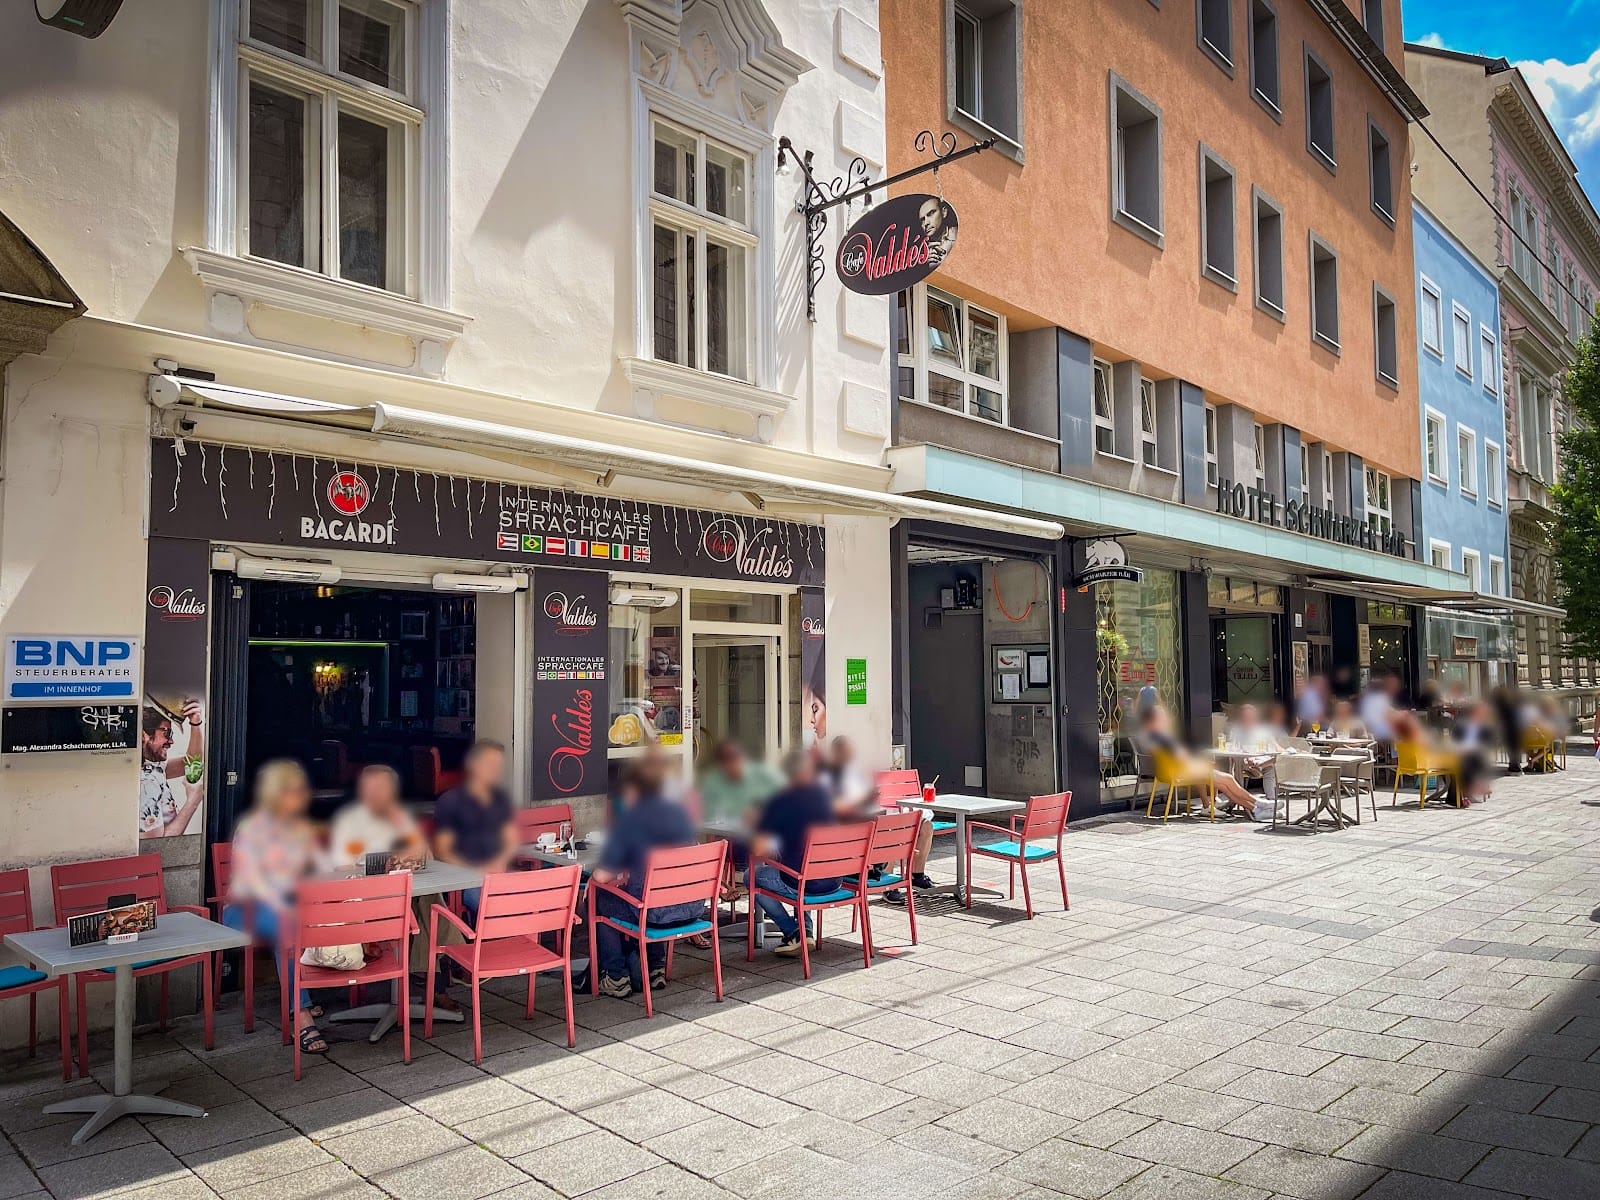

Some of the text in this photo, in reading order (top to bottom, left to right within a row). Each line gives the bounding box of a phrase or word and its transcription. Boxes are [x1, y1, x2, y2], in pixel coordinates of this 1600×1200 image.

[839, 223, 930, 281] Valdés
[499, 496, 650, 525] INTERNATIONALES
[1217, 477, 1280, 526] HOTEL
[703, 519, 794, 578] Valdés
[148, 585, 206, 614] Valdés
[543, 591, 598, 626] Valdés
[15, 639, 131, 666] BNP
[537, 662, 605, 671] SPRACHCAFE
[44, 685, 102, 694] IM INNENHOF
[12, 745, 29, 753] Mag.
[29, 743, 62, 751] Alexandra
[549, 689, 593, 793] Valdés
